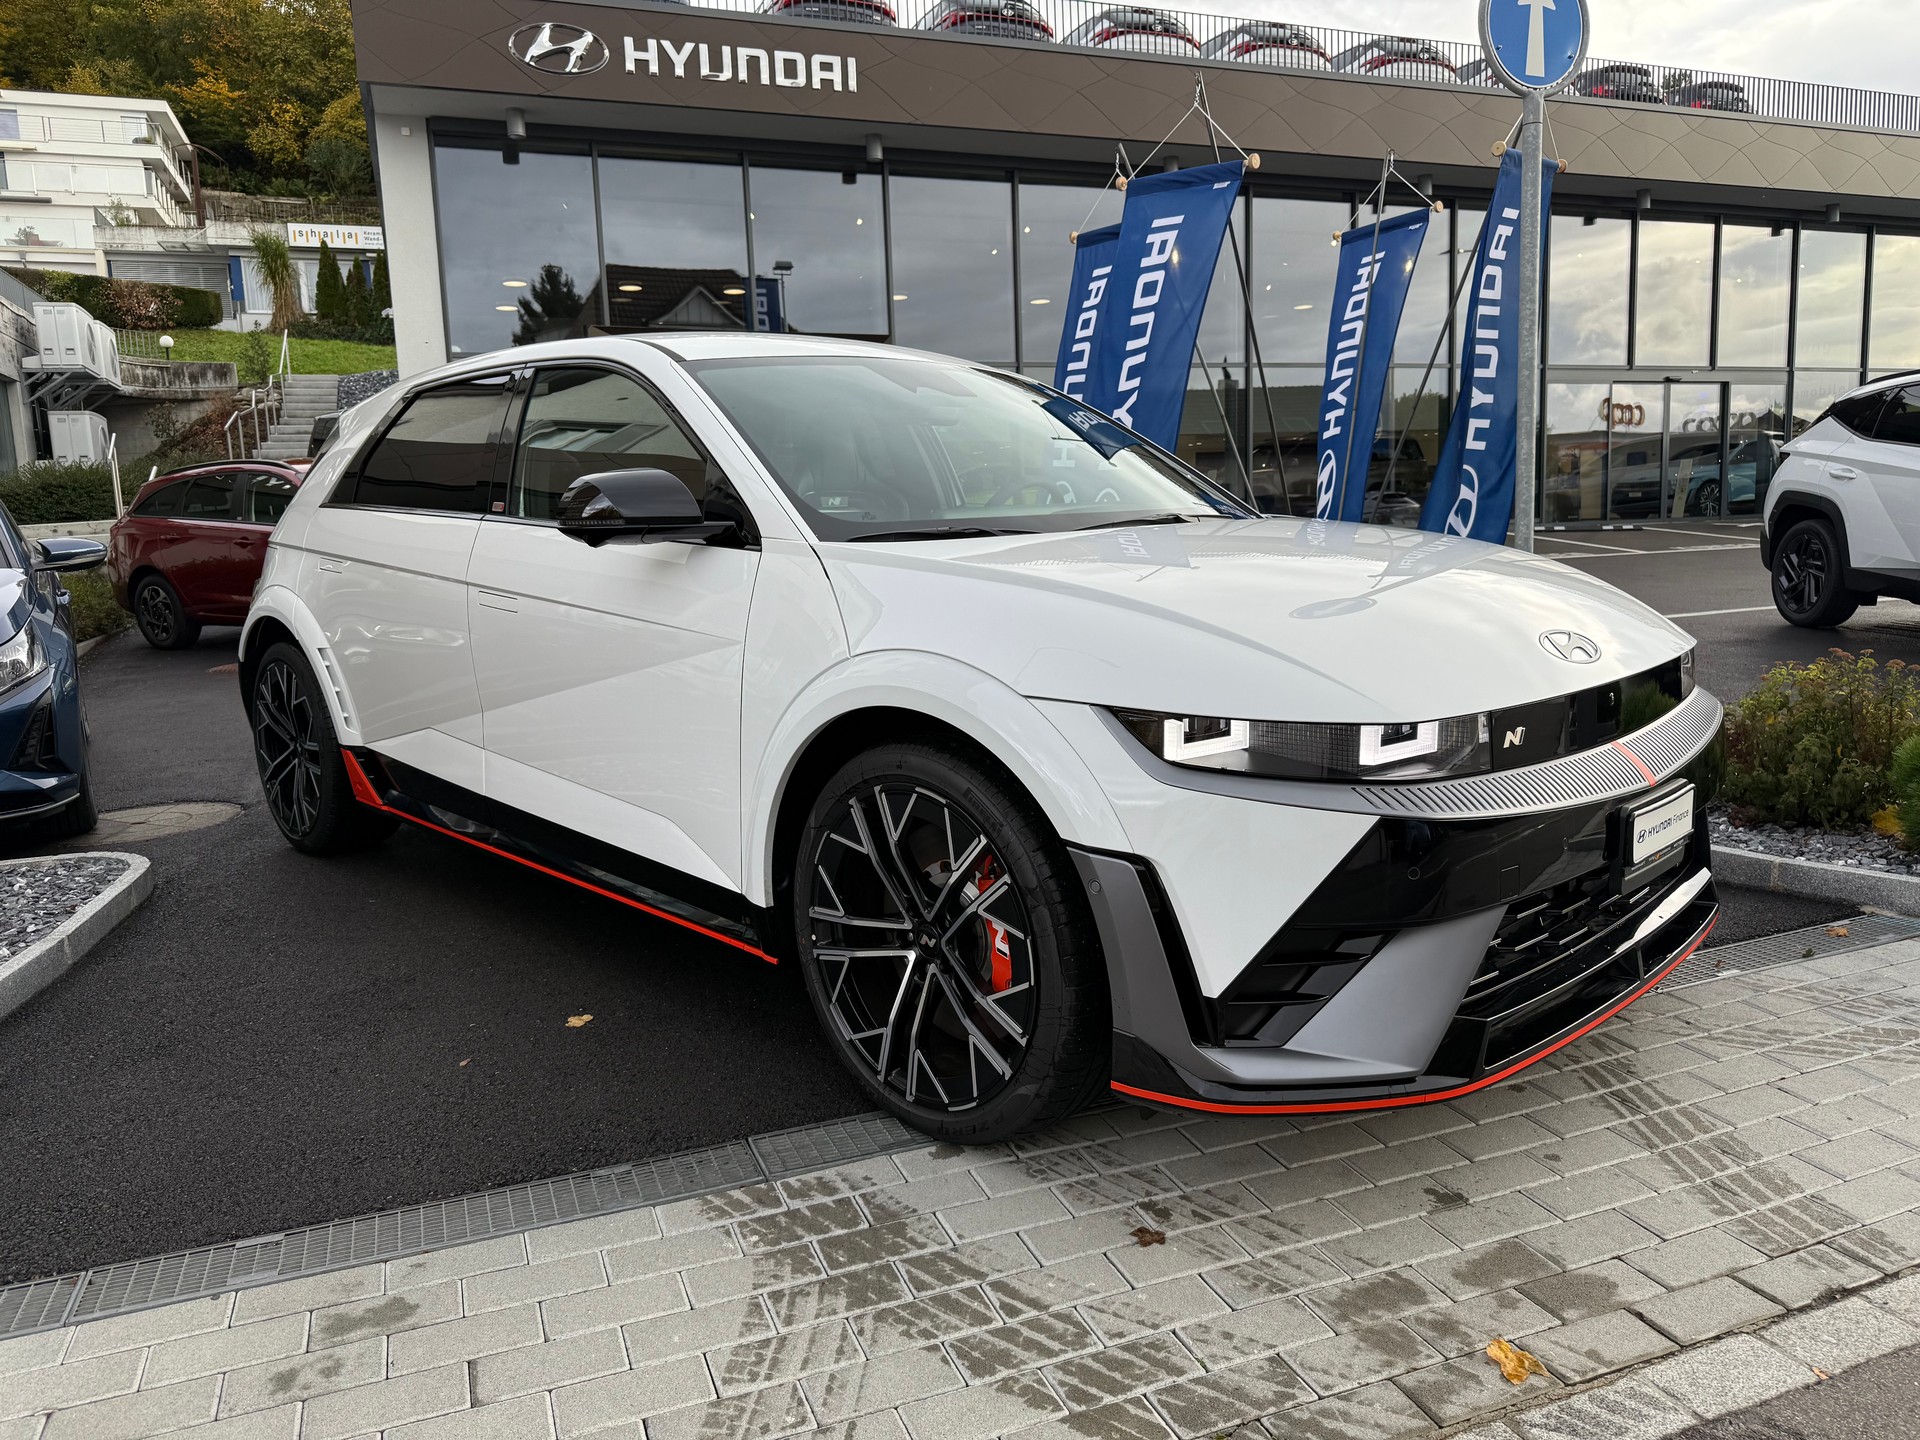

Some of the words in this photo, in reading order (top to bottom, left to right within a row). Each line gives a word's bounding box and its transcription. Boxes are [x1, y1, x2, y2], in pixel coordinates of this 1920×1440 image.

[624, 36, 857, 93] HYUNDAI
[1648, 816, 1673, 838] HYUNDAI
[1673, 809, 1689, 825] Finance
